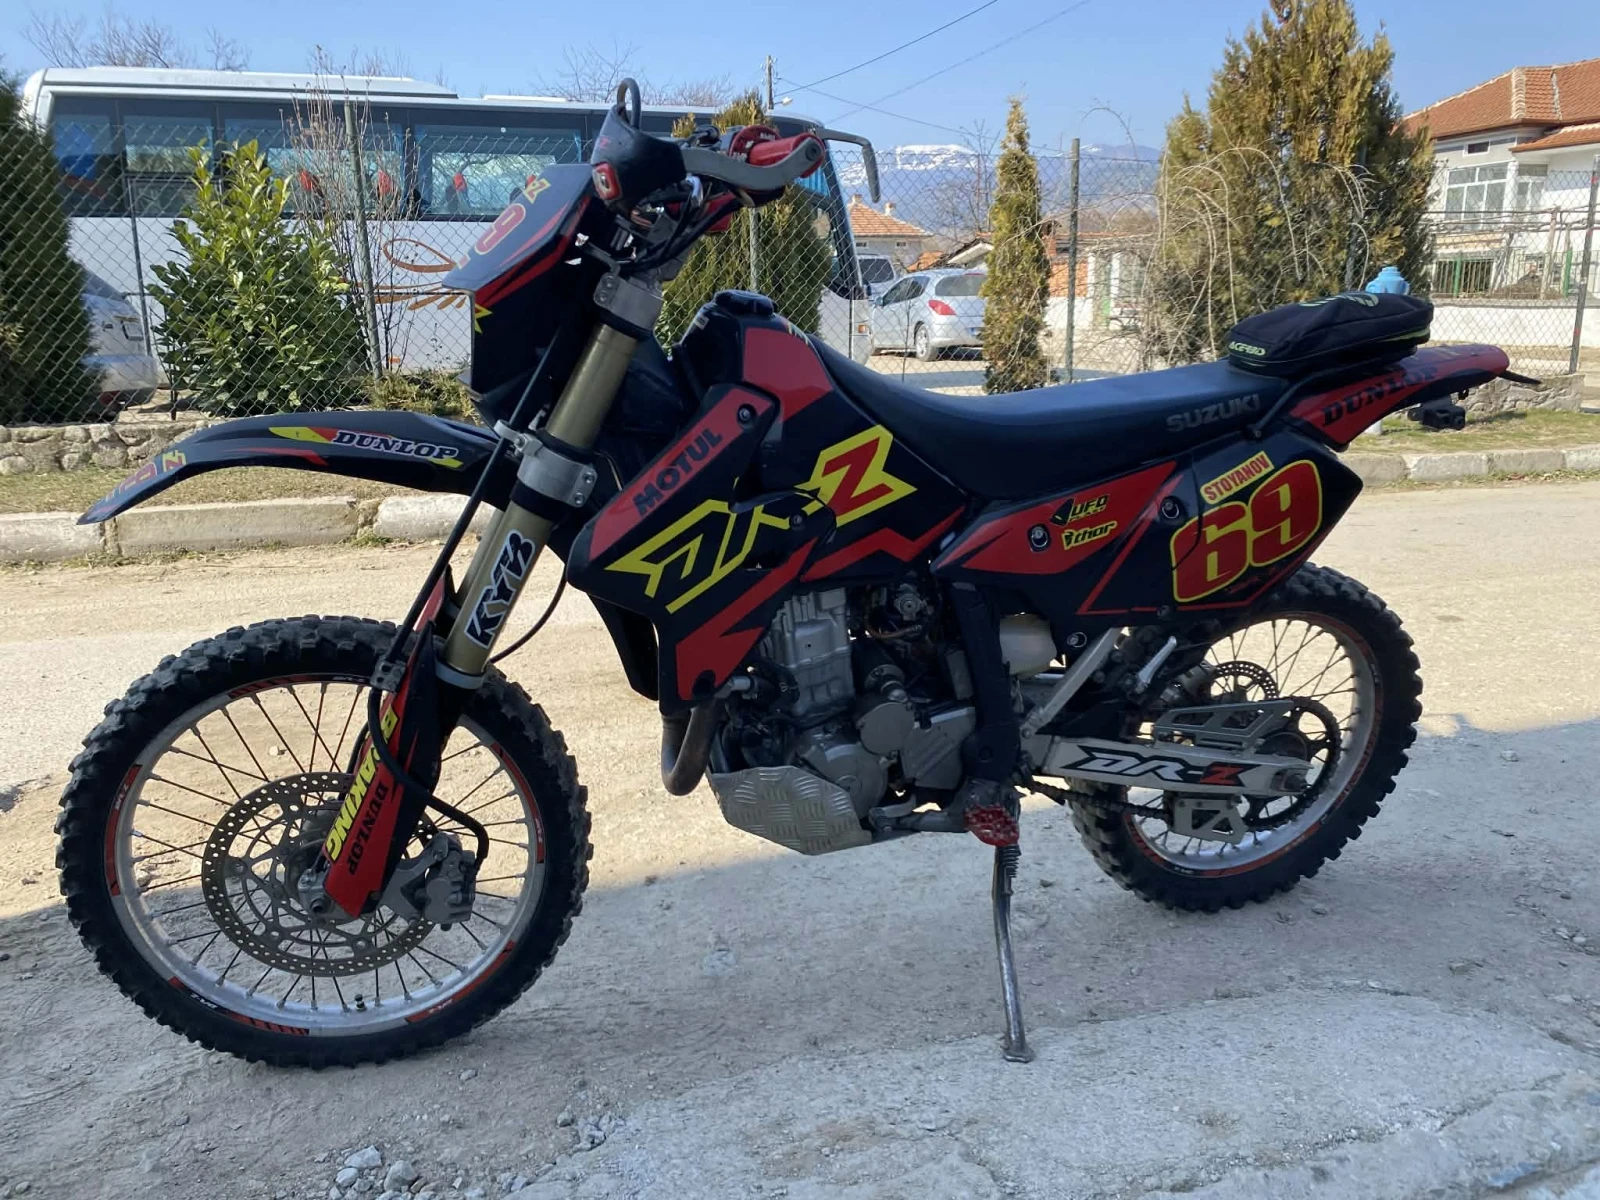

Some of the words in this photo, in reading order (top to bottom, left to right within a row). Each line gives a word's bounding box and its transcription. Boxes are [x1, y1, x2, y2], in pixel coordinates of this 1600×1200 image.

[1166, 393, 1261, 433] SUZUKI
[1323, 366, 1438, 427] DUNLOP
[331, 430, 460, 460] DUNLOP
[631, 428, 723, 519] MOTUL
[1203, 454, 1271, 501] STOYANOV
[1070, 495, 1109, 517] UFO
[1170, 460, 1322, 602] 69
[464, 529, 535, 649] KYB
[1070, 748, 1250, 787] DR-Z
[347, 778, 390, 876] DUNLOP
